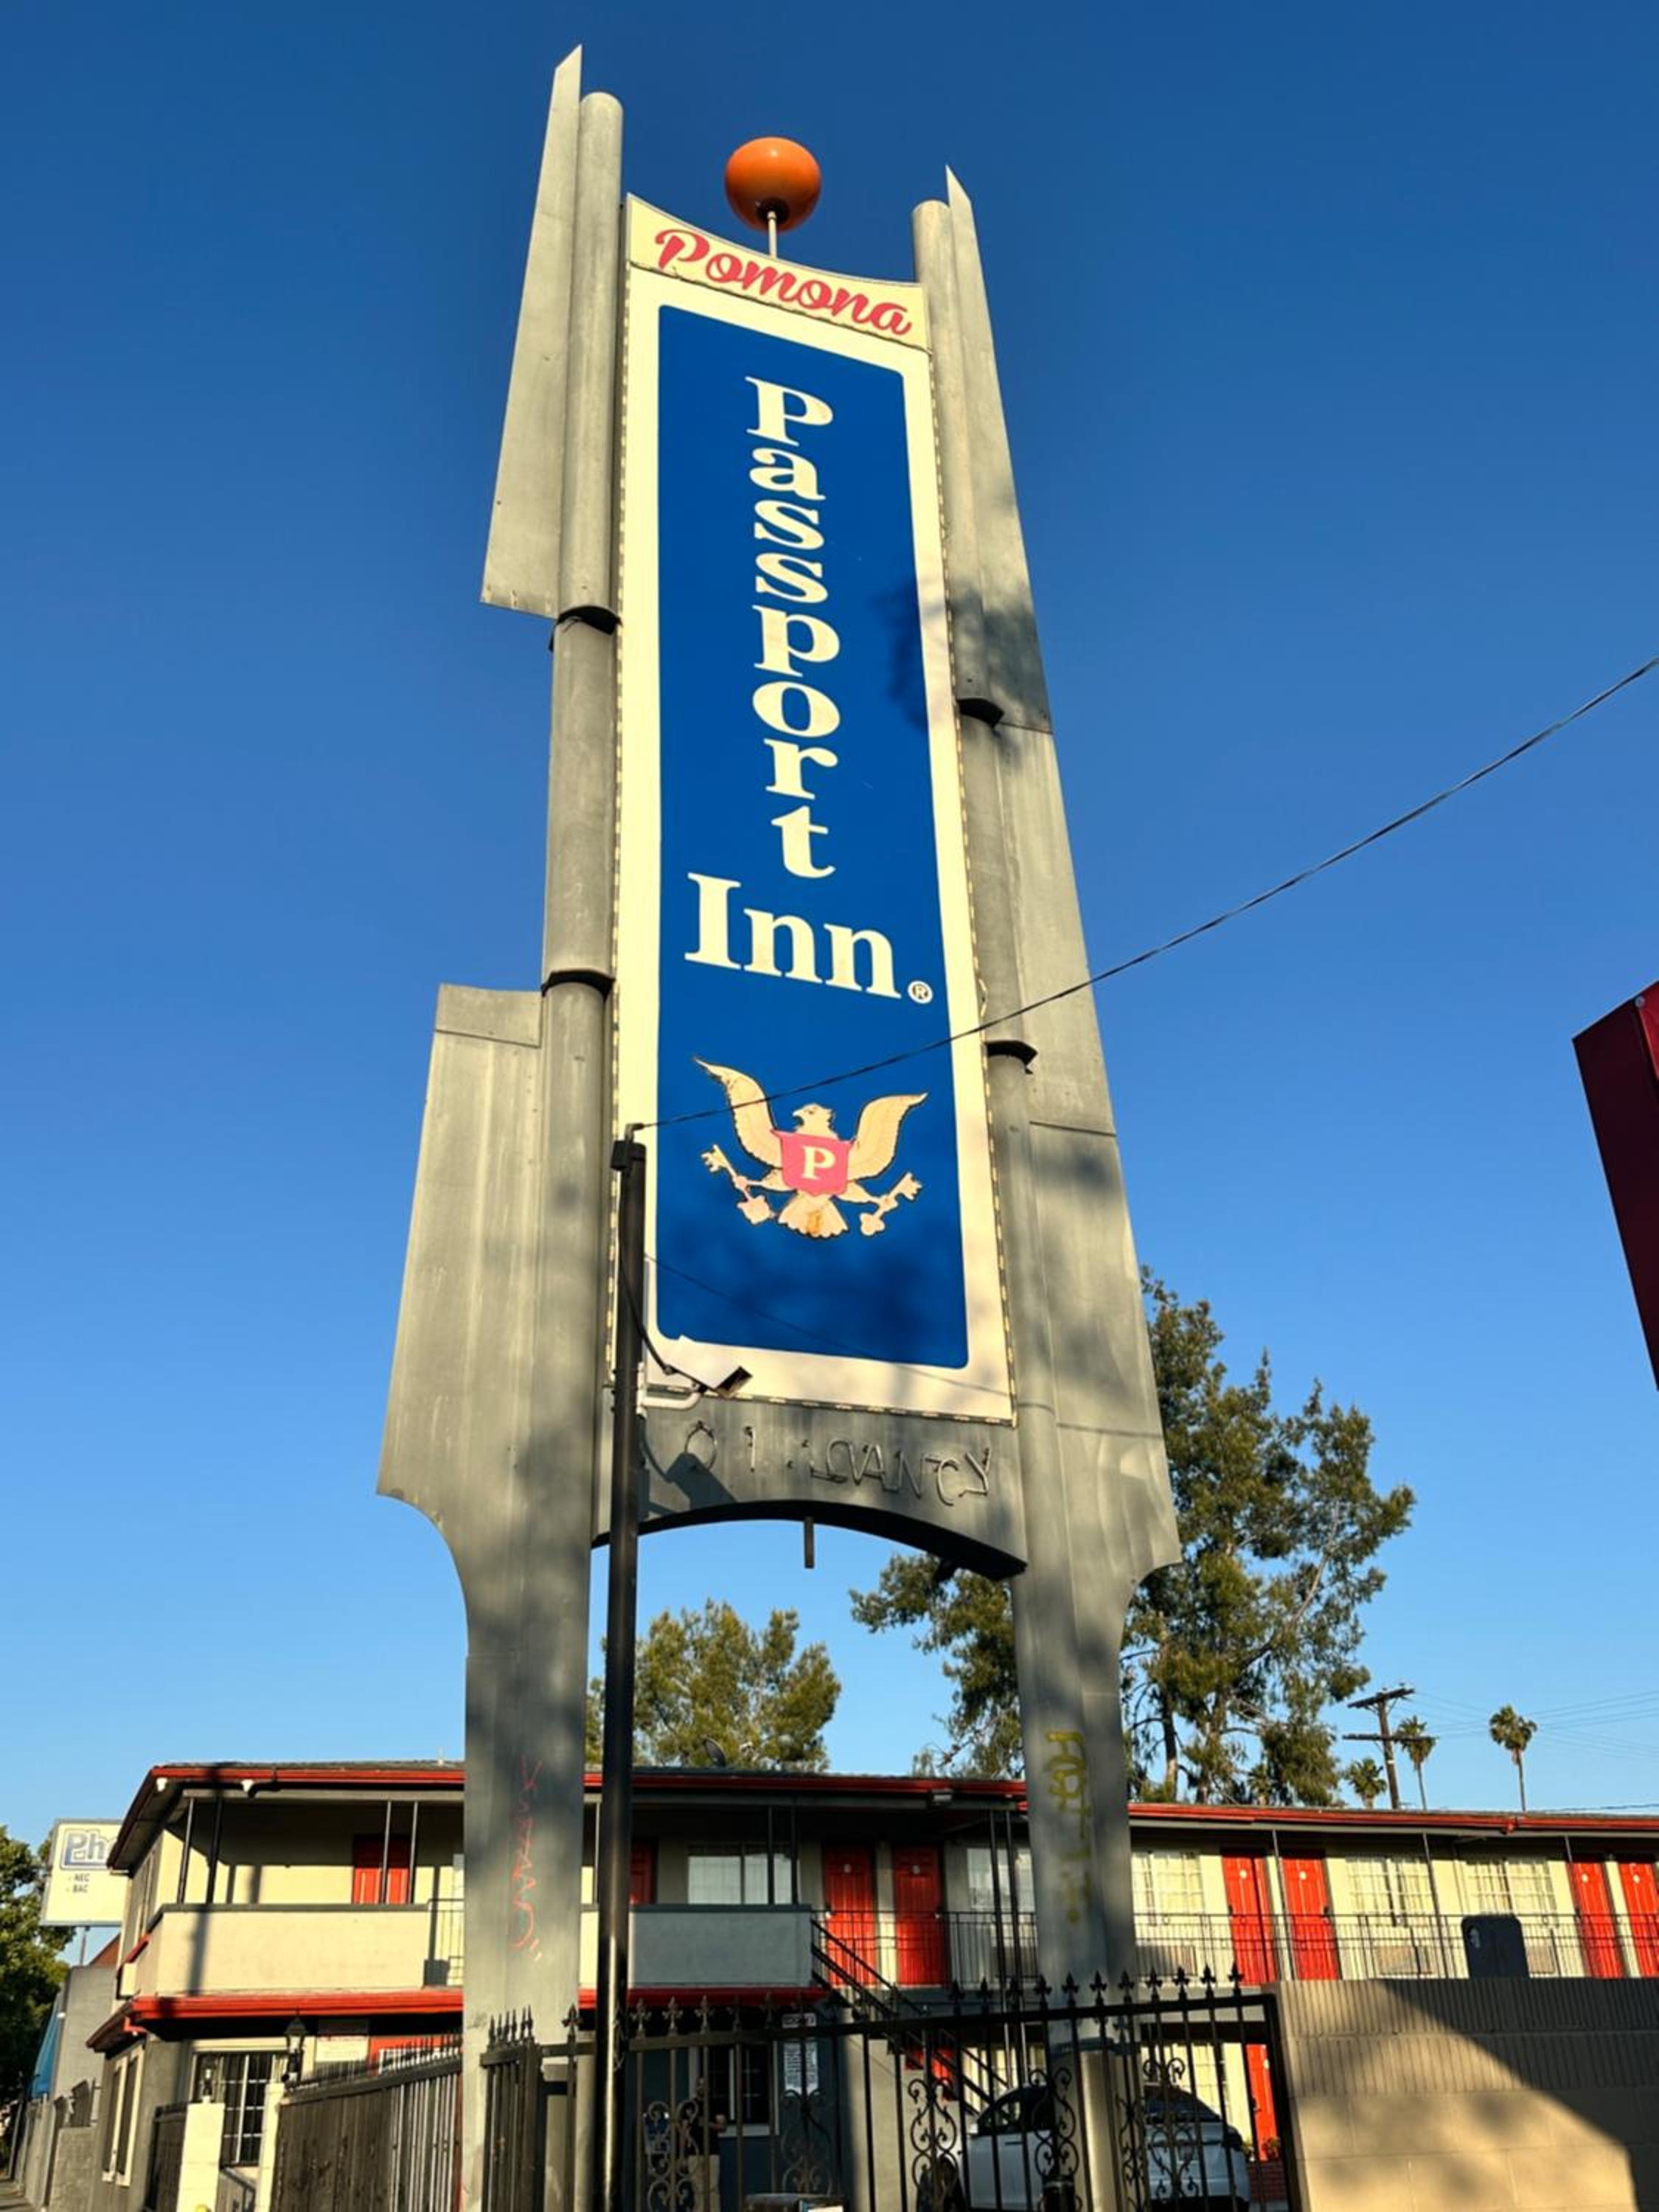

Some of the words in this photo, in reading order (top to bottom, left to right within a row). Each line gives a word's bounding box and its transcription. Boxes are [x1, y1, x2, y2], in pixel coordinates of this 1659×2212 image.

[655, 229, 912, 335] Pomona
[745, 376, 840, 879] Passport
[801, 1146, 836, 1180] P
